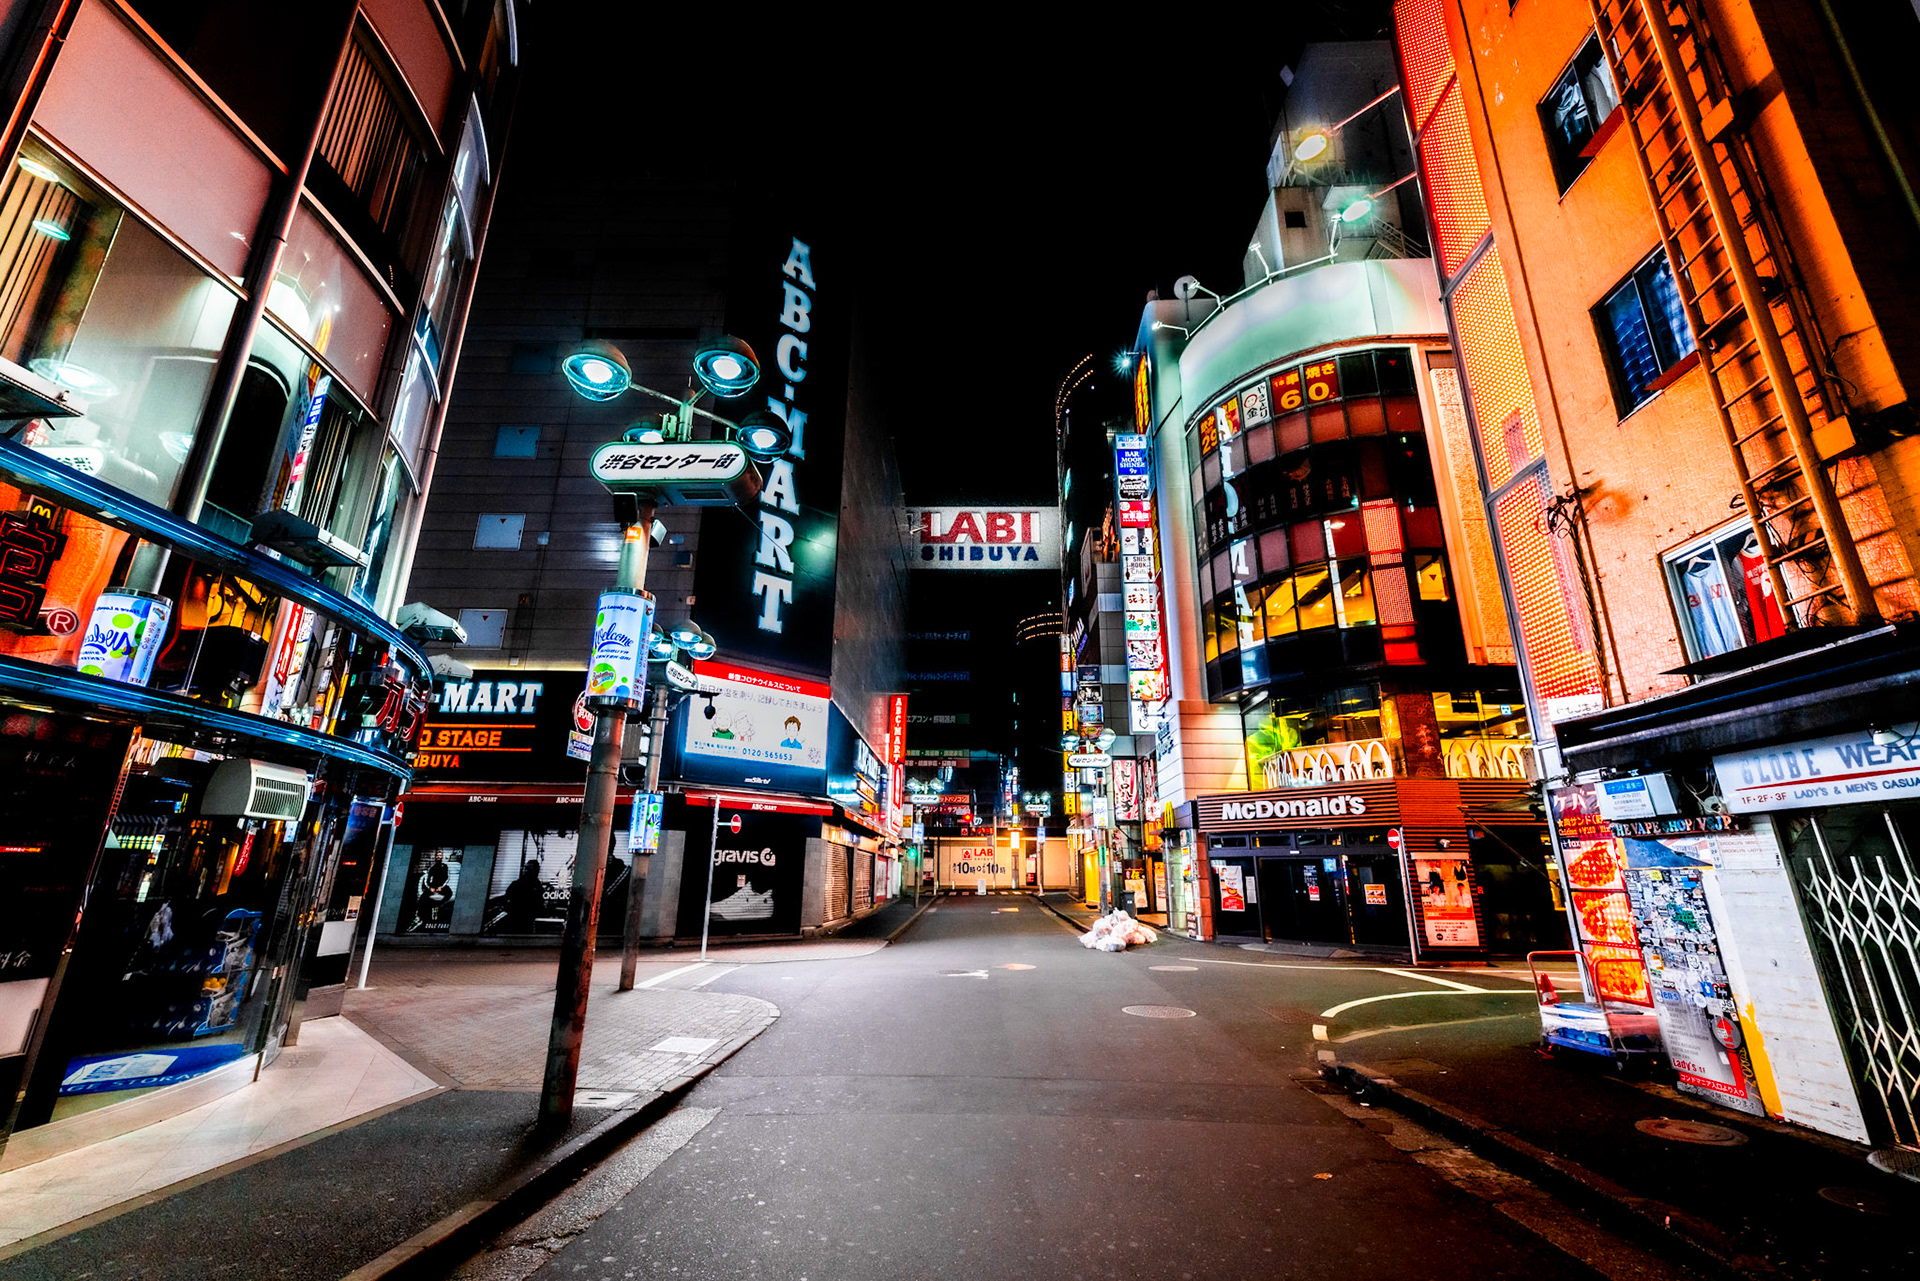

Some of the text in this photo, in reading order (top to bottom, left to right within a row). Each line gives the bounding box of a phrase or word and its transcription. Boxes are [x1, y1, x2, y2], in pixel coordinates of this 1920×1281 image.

[600, 453, 740, 470] 渋谷センター街
[920, 511, 1041, 544] LABI
[921, 546, 1039, 561] SHIBUYA
[595, 622, 634, 648] Welcome
[728, 672, 802, 693] 新型コロナウイルスについて
[894, 697, 903, 763] ABC-MART
[437, 730, 502, 748] STAGE
[1794, 787, 1829, 800] LADY'S
[1833, 786, 1842, 795] &
[1846, 781, 1878, 793] MEN'S
[752, 803, 778, 811] ABC-MART
[1221, 794, 1366, 821] McDonald's
[1630, 821, 1661, 836] VAPE
[713, 849, 759, 866] gravis
[1661, 988, 1680, 1001] en's
[1672, 1058, 1697, 1073] Lady's
